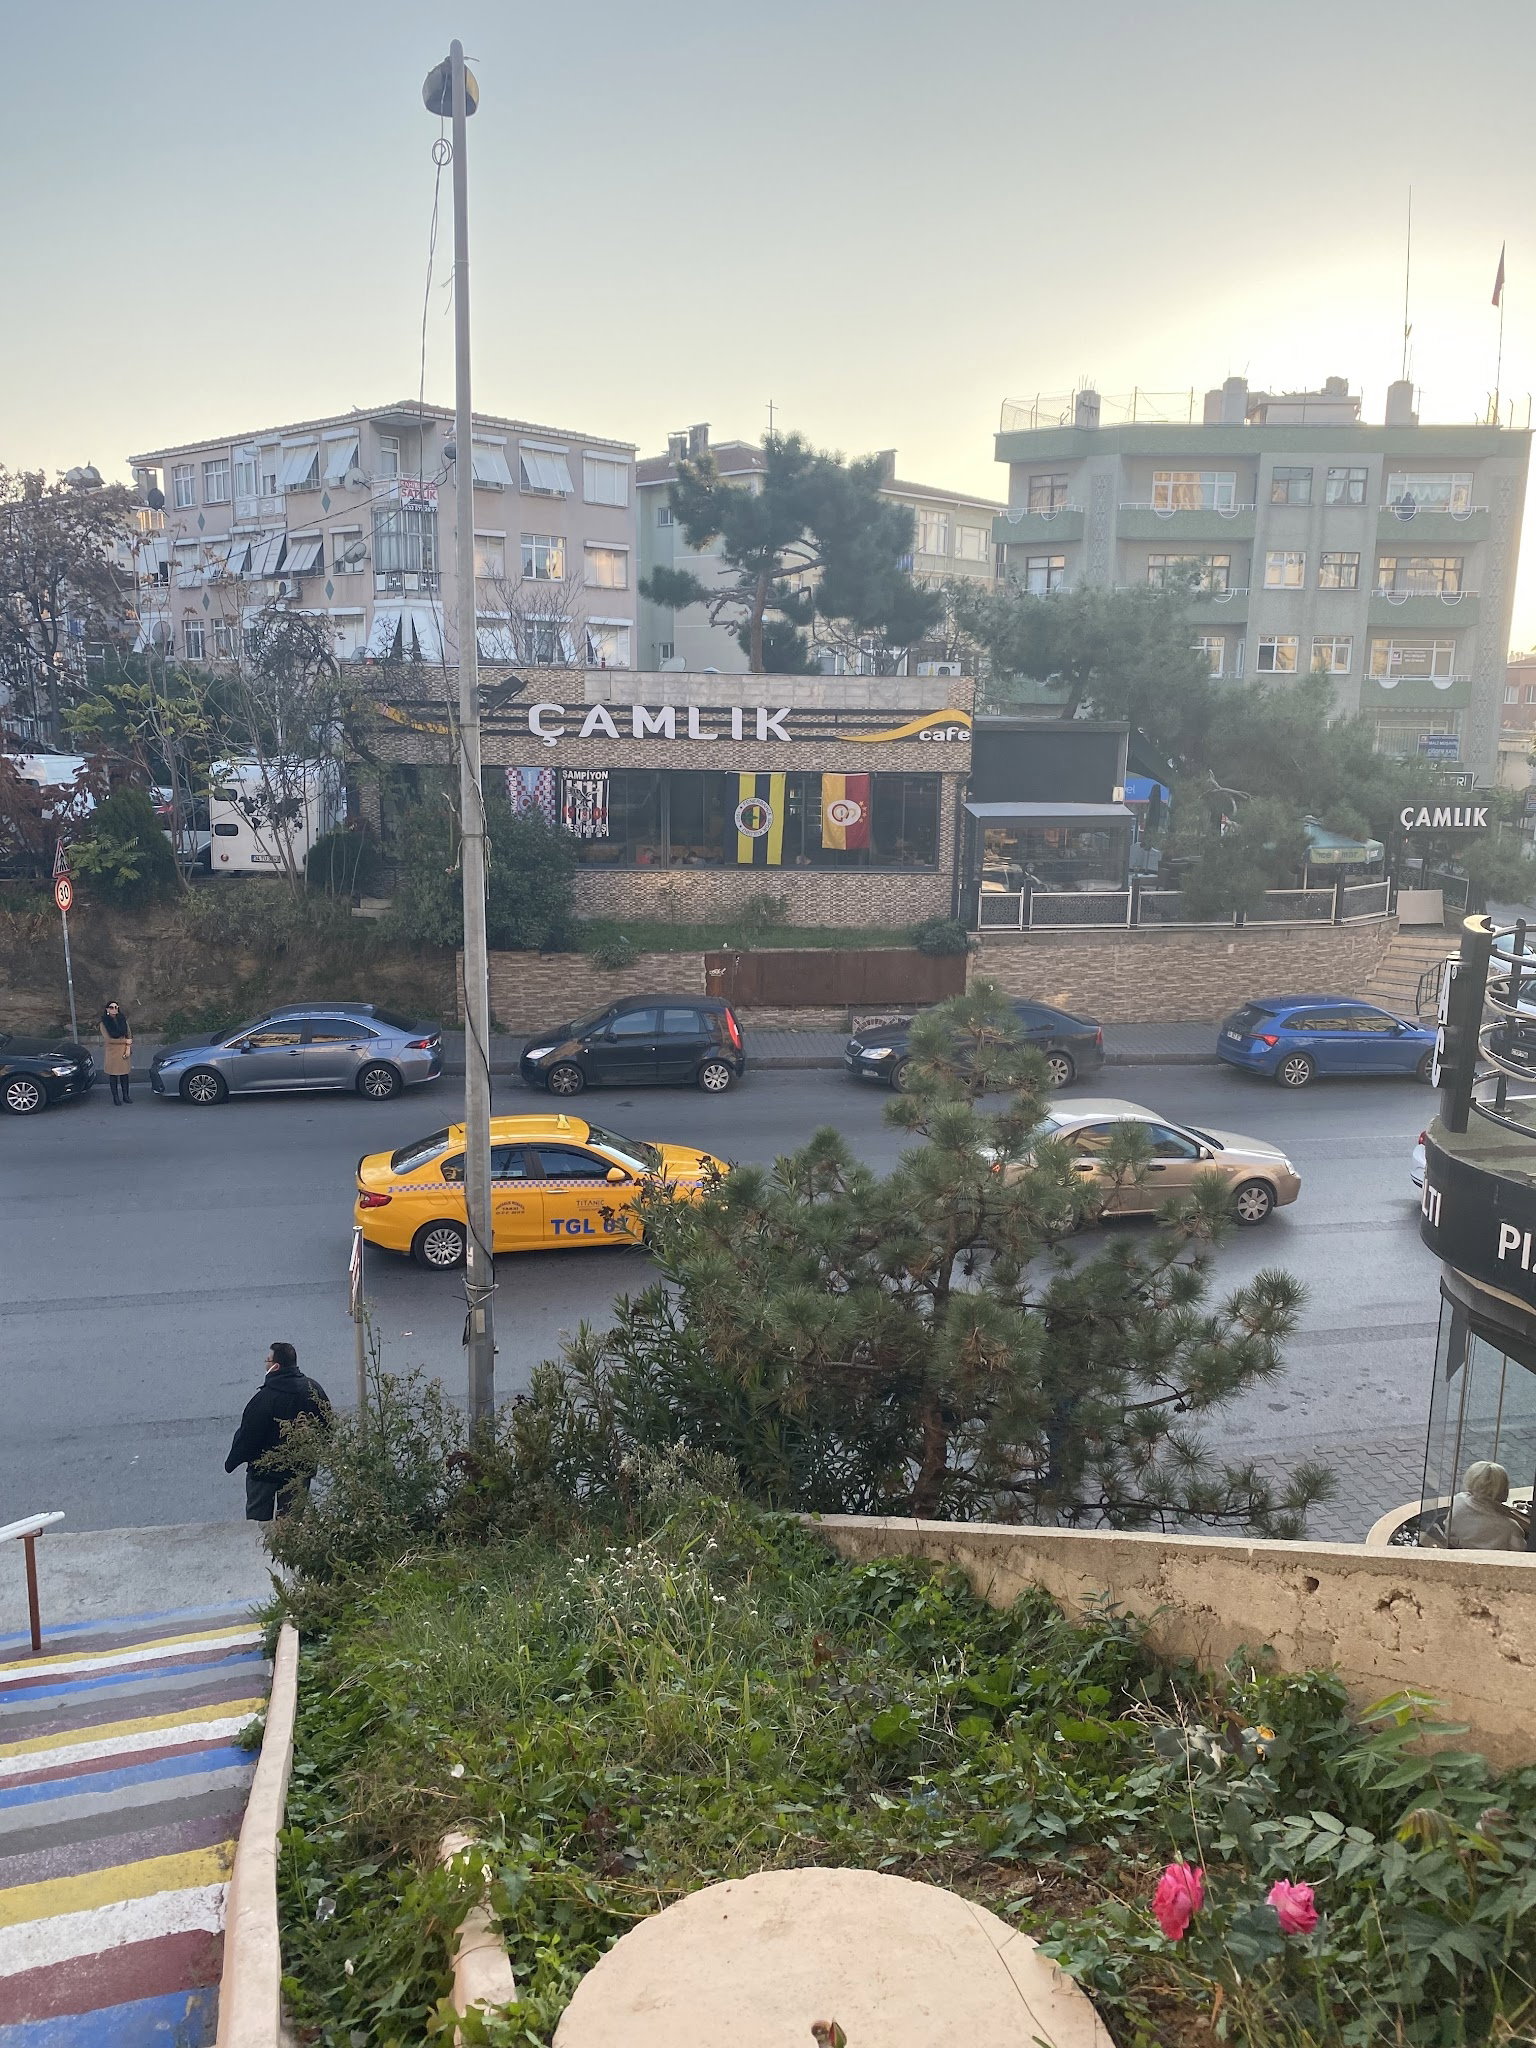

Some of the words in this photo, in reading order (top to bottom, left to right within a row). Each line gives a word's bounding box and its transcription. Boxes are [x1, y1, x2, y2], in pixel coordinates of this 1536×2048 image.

[528, 703, 792, 747] ÇAMLIK
[919, 726, 971, 741] cafe
[562, 769, 609, 780] ŞAMPİYON
[1400, 806, 1489, 831] ÇAMLIK
[59, 885, 69, 901] 30
[551, 1218, 595, 1235] TGL
[1498, 1222, 1536, 1274] PI
